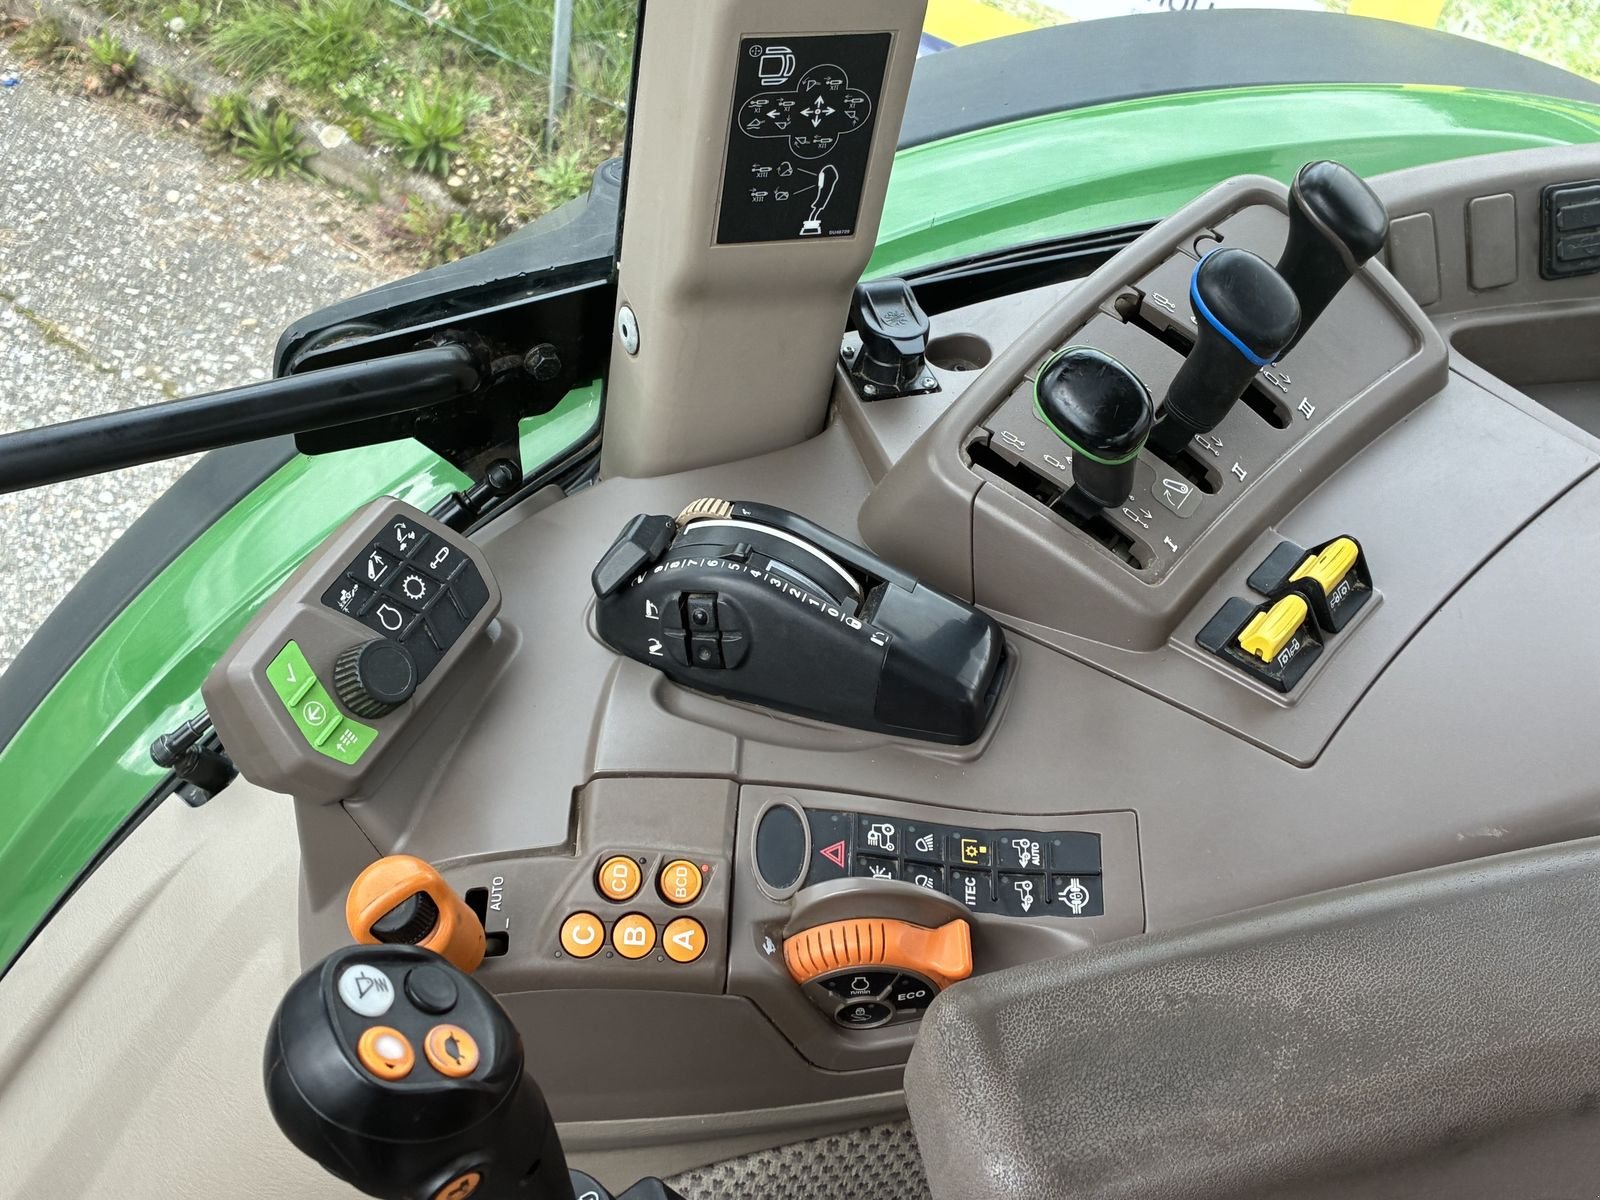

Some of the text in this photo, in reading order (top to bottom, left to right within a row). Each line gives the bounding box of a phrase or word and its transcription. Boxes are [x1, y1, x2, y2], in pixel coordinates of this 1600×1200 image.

[1298, 397, 1315, 419] III
[1231, 462, 1247, 482] II
[750, 569, 761, 578] 4
[770, 578, 781, 587] 3
[789, 588, 801, 599] 2
[809, 598, 820, 607] 1
[827, 608, 839, 617] 0
[1031, 842, 1040, 866] AUTO
[611, 864, 628, 892] CD
[675, 866, 688, 898] BCD
[490, 876, 504, 911] AUTO
[965, 877, 976, 905] iTEC
[572, 925, 595, 945] C
[623, 926, 646, 946] B
[672, 929, 695, 951] A
[898, 990, 926, 1001] ECO
